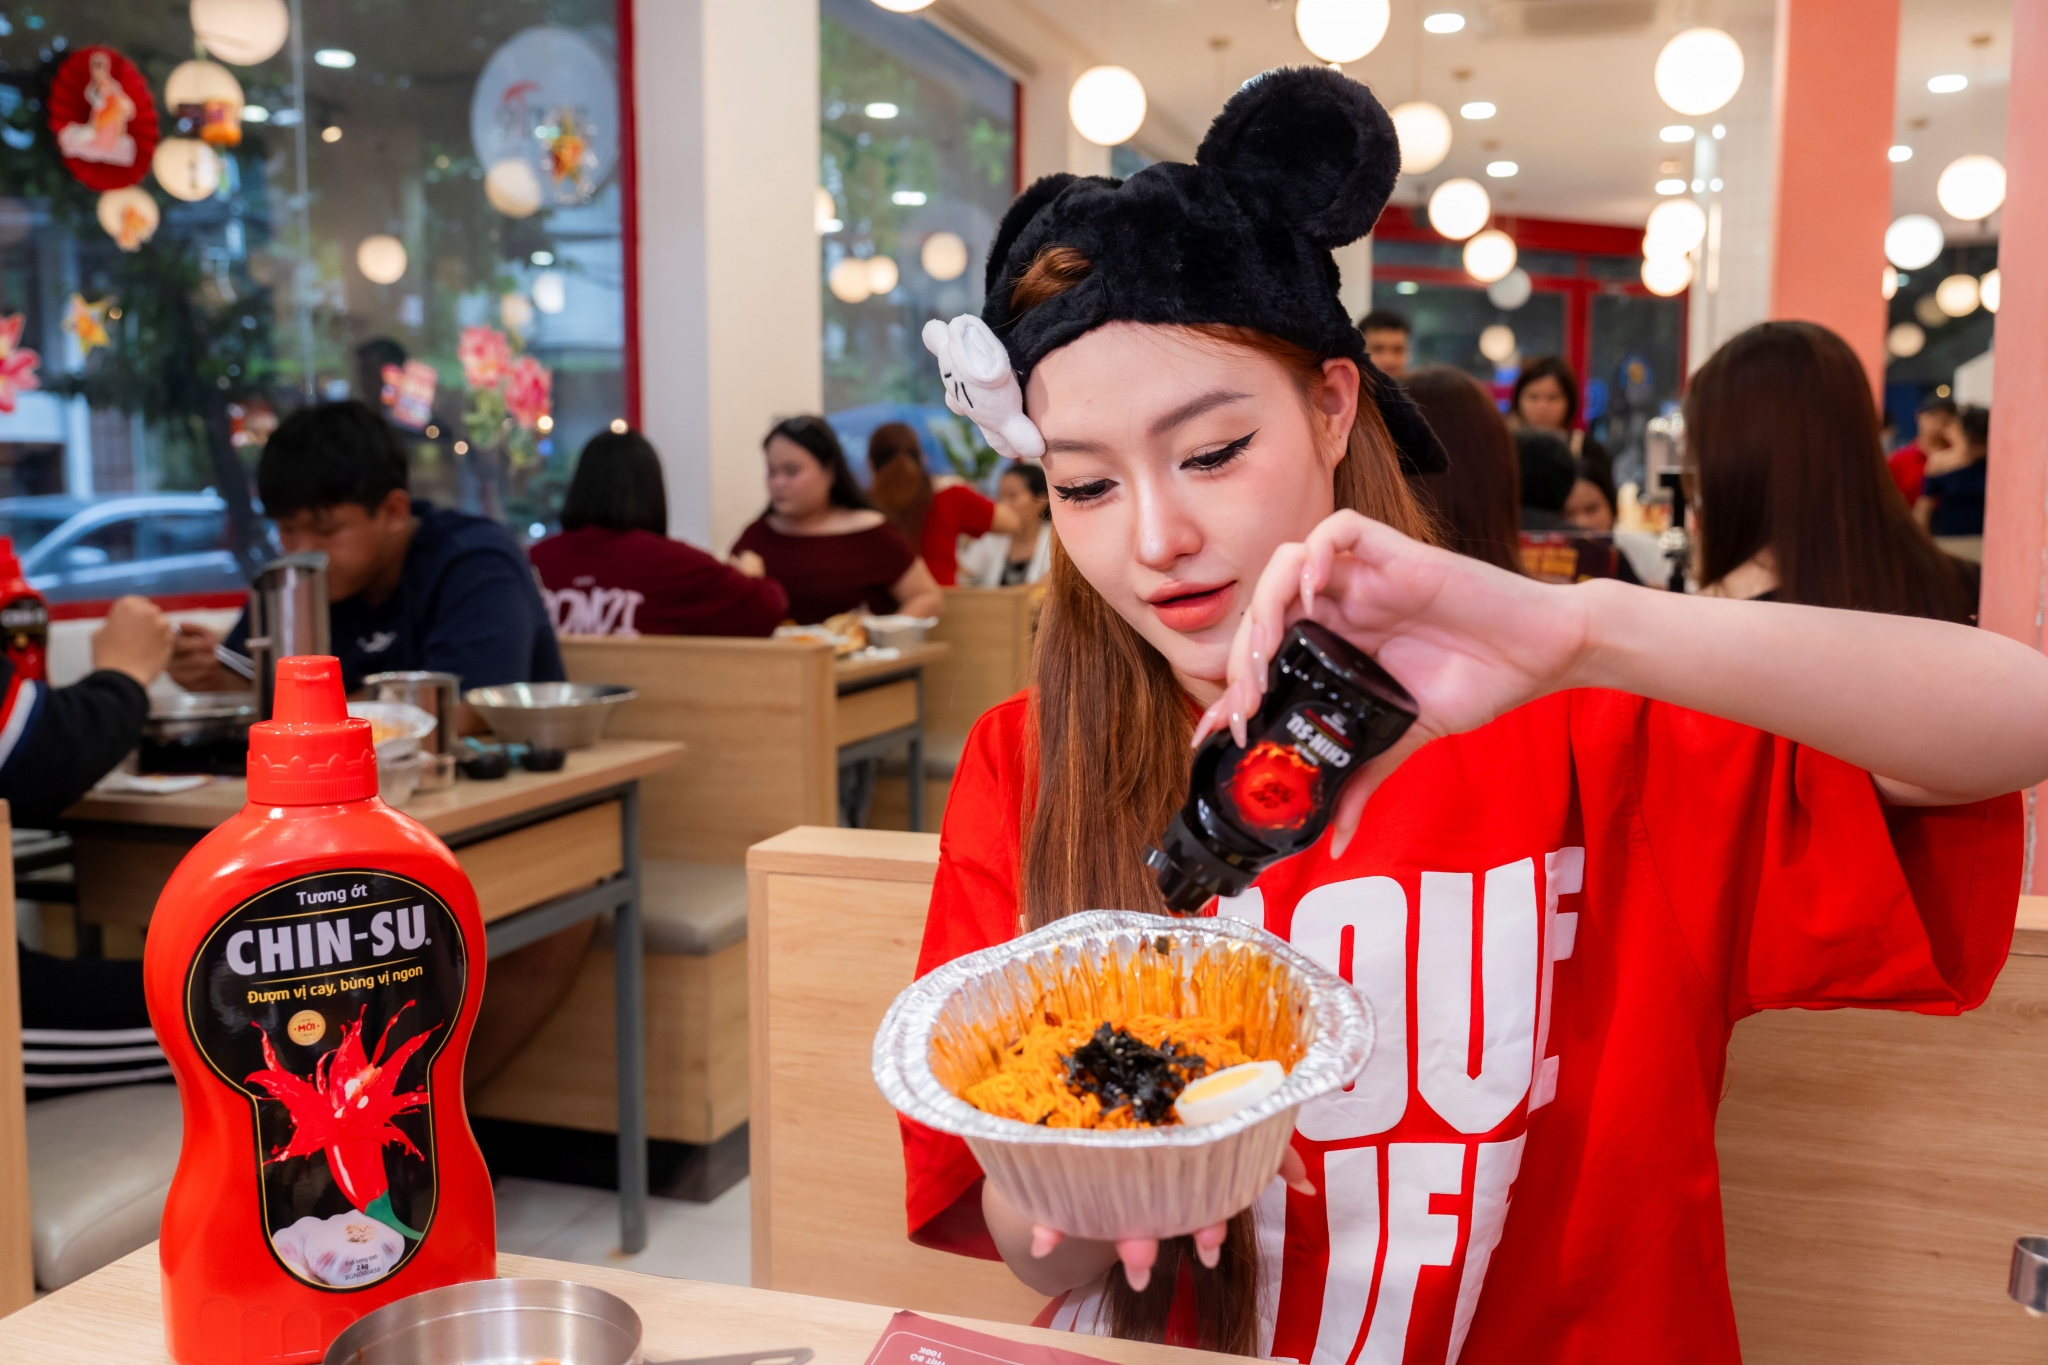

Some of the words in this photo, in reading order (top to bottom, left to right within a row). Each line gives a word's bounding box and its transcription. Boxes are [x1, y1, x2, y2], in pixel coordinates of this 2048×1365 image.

[1286, 712, 1351, 768] CHIN-SU
[296, 888, 347, 906] Tương
[350, 884, 368, 898] ớt
[226, 904, 427, 976] CHIN-SU
[247, 988, 290, 1005] Đượm
[294, 984, 307, 1000] vị
[310, 982, 337, 998] cay,
[340, 975, 375, 992] bùng
[377, 970, 390, 986] vị
[392, 965, 423, 983] ngon
[918, 1347, 942, 1358] 100K
